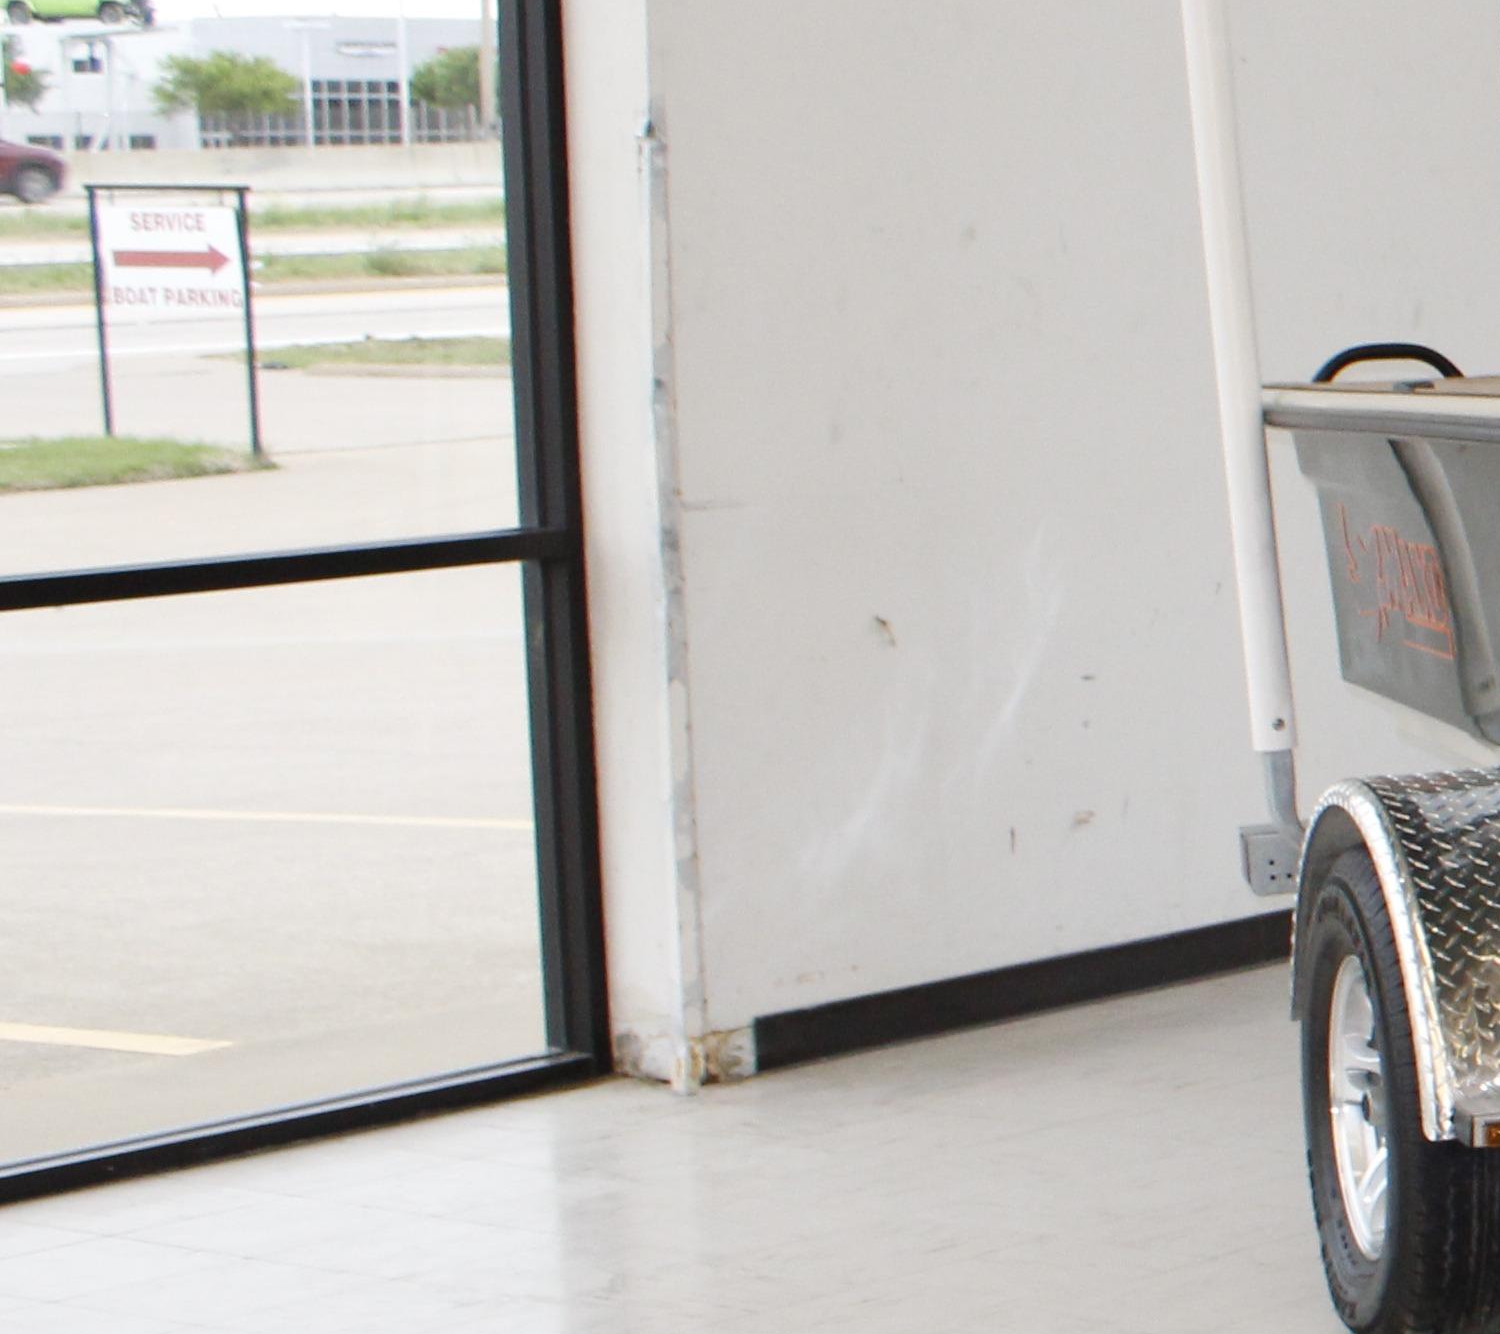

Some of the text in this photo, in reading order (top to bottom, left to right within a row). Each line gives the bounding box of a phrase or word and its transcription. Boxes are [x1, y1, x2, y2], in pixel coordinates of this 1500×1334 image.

[130, 212, 206, 232] SERVICE
[113, 286, 244, 308] BOAT PARKING
